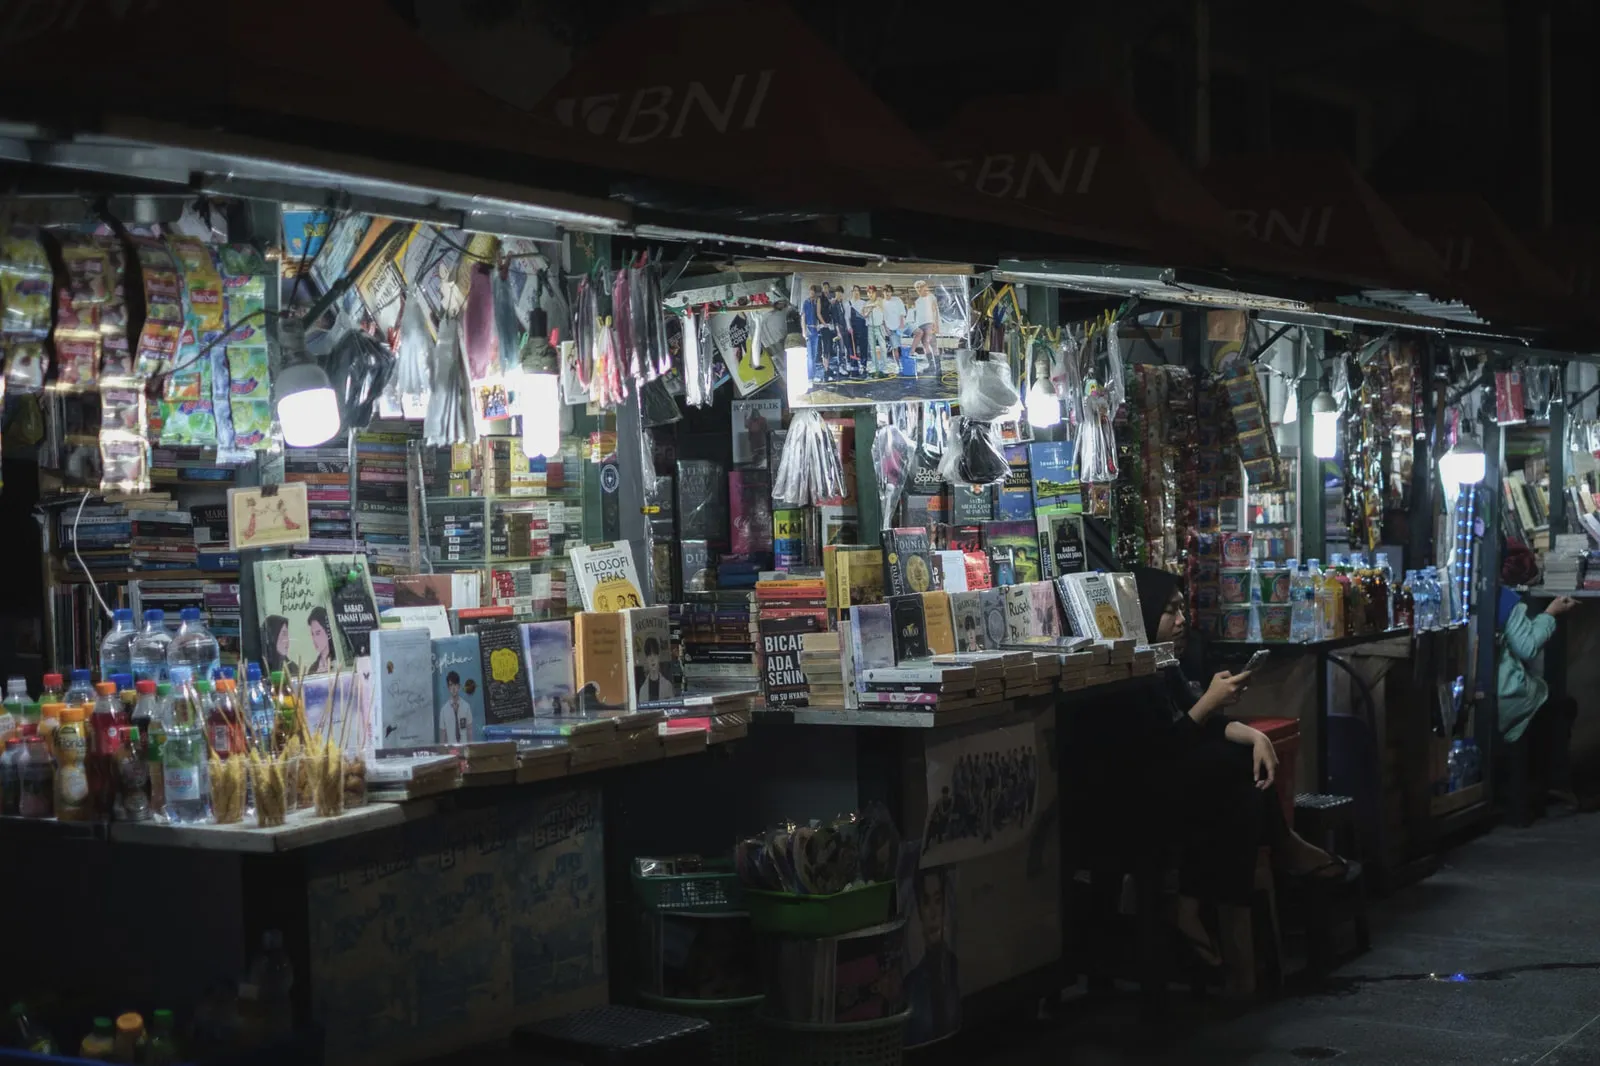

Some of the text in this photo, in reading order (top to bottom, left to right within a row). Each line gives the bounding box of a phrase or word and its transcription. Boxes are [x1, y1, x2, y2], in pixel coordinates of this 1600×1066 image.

[616, 69, 776, 144] BNI
[975, 146, 1102, 200] BNI
[584, 555, 630, 575] FILOSOFI
[593, 569, 627, 583] TERAS
[343, 603, 364, 614] BABAD
[336, 613, 358, 623] TANAH
[764, 634, 804, 653] BICAR
[767, 654, 793, 672] ADA
[768, 670, 804, 687] SENIN
